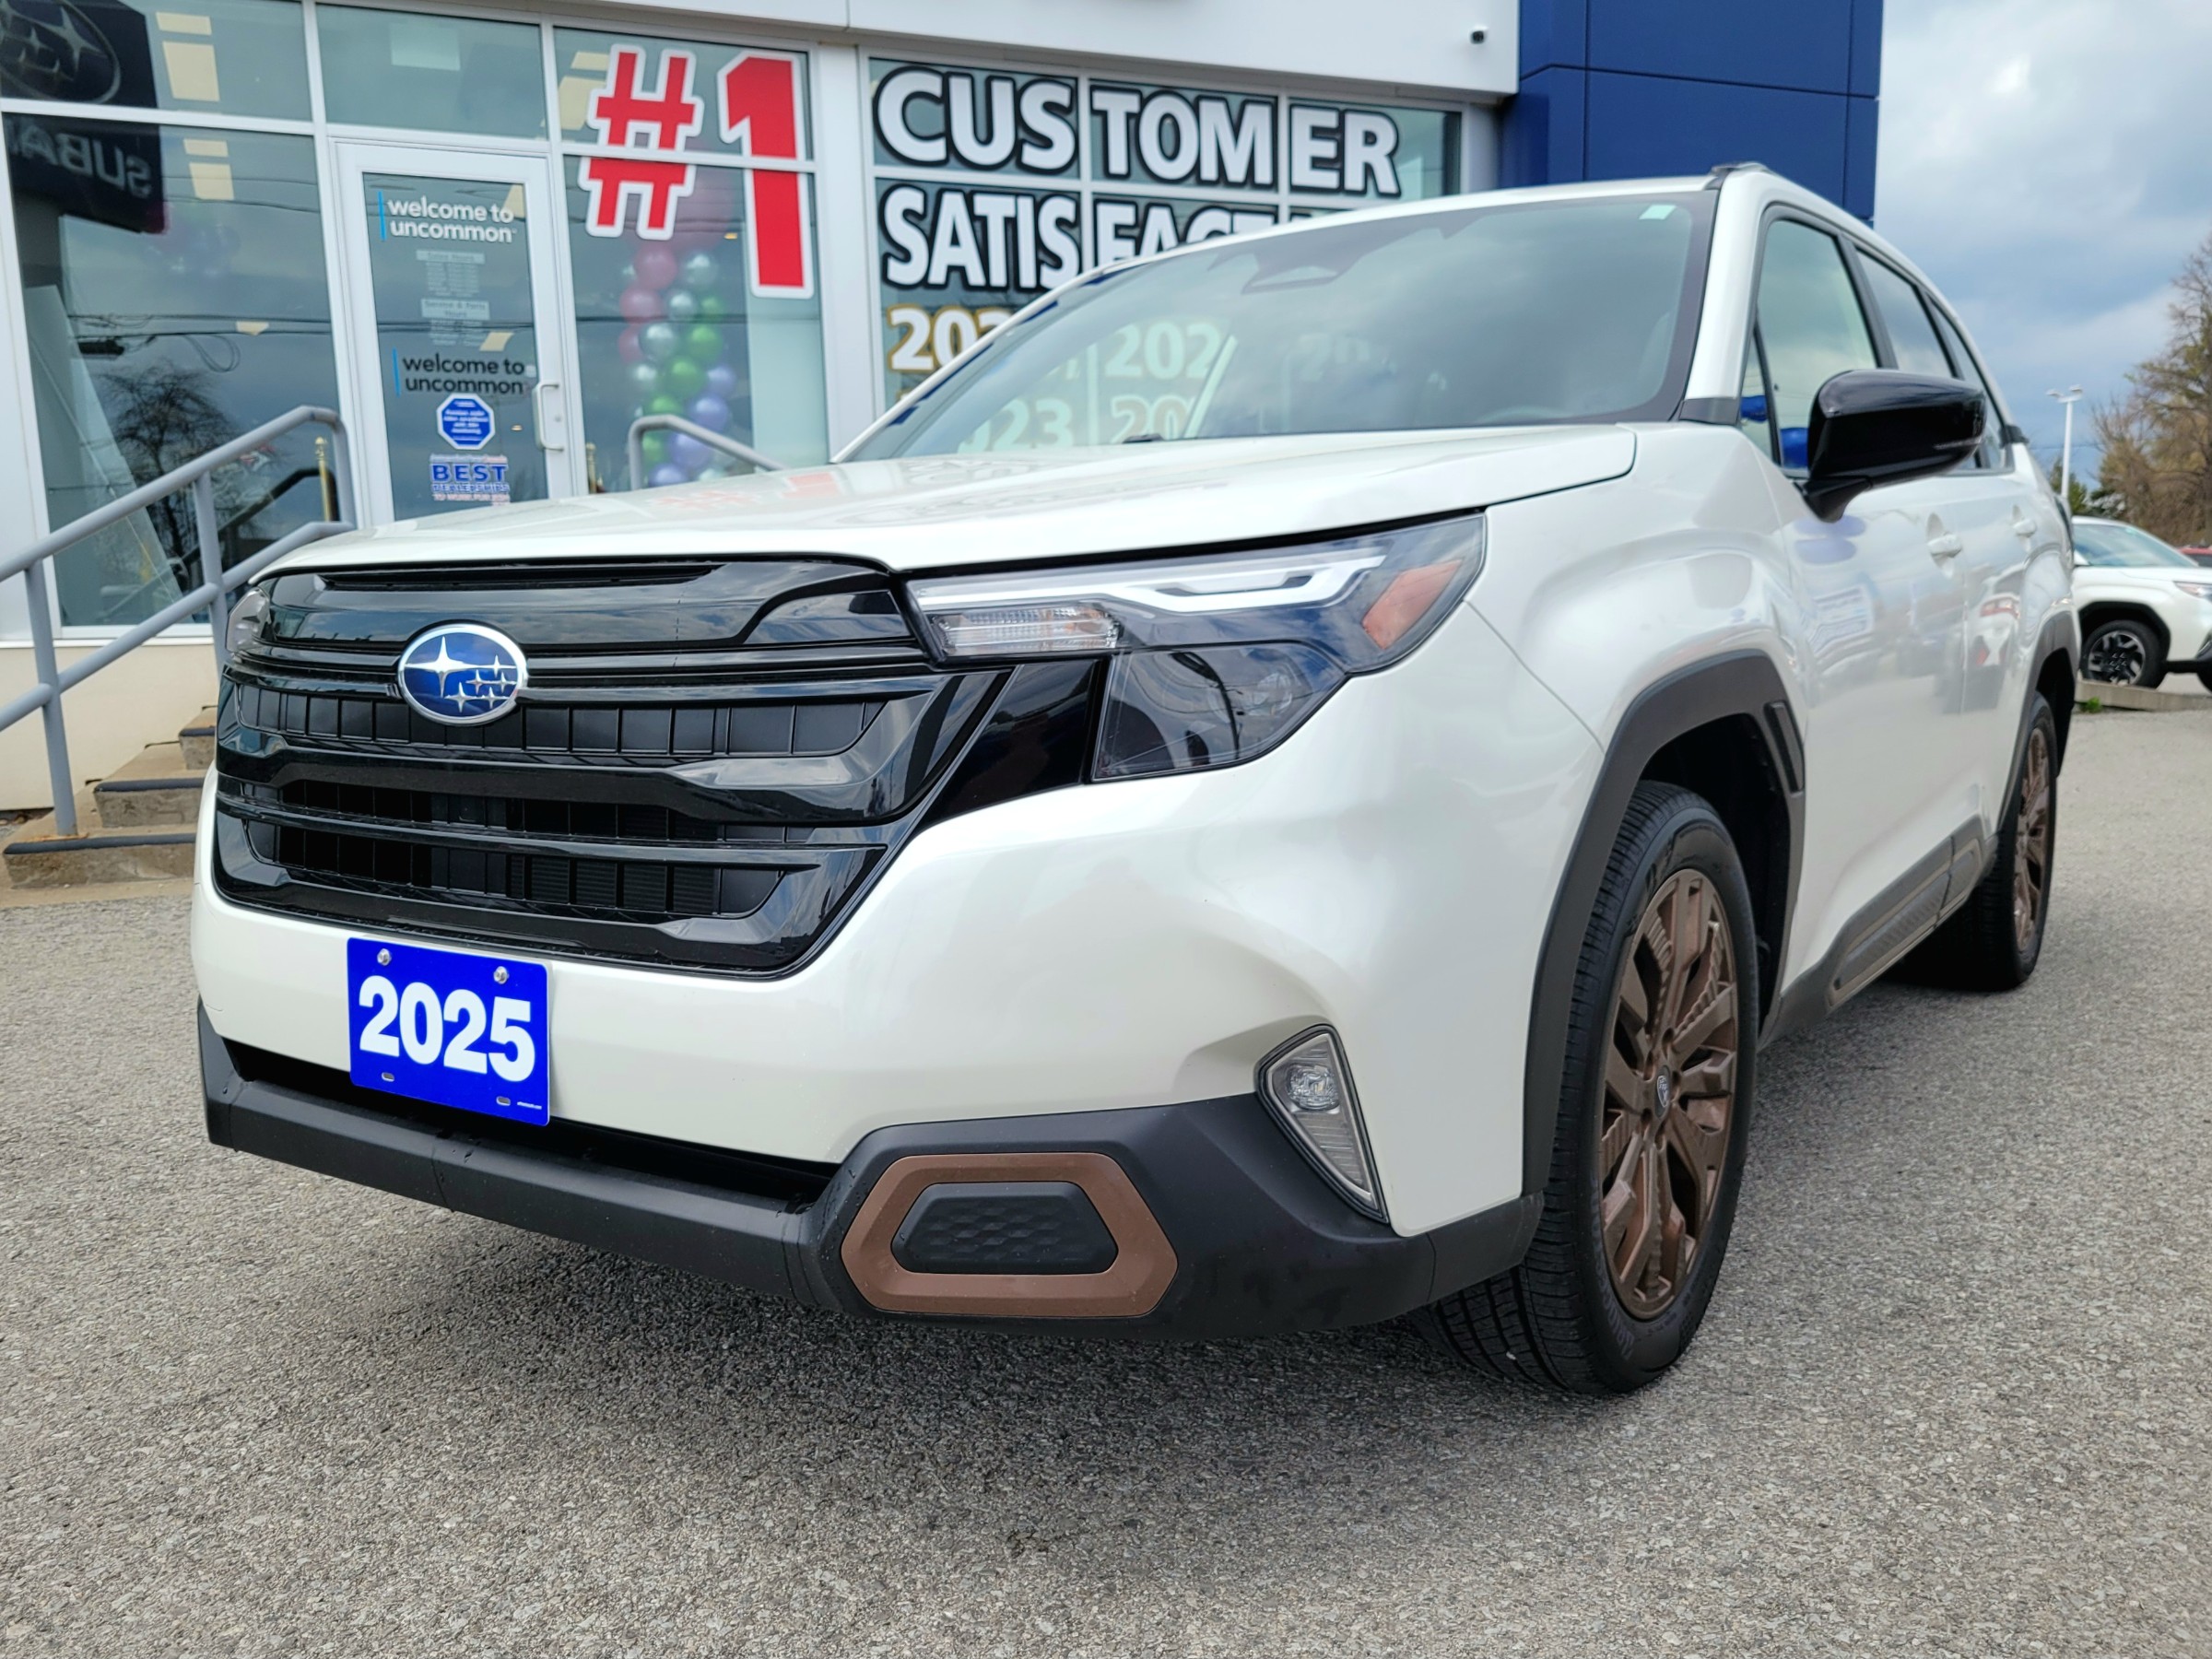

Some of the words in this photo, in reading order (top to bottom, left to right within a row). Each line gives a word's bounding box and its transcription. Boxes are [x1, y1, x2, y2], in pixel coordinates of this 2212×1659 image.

[872, 65, 1401, 197] CUSTOMER
[577, 43, 814, 300] #1
[387, 195, 488, 221] welcome
[490, 204, 514, 223] to
[390, 219, 512, 242] uncommon
[403, 352, 499, 374] welcome
[503, 359, 525, 376] to
[405, 378, 524, 394] uncommon
[430, 463, 508, 483] BEST
[359, 975, 535, 1082] 2025
